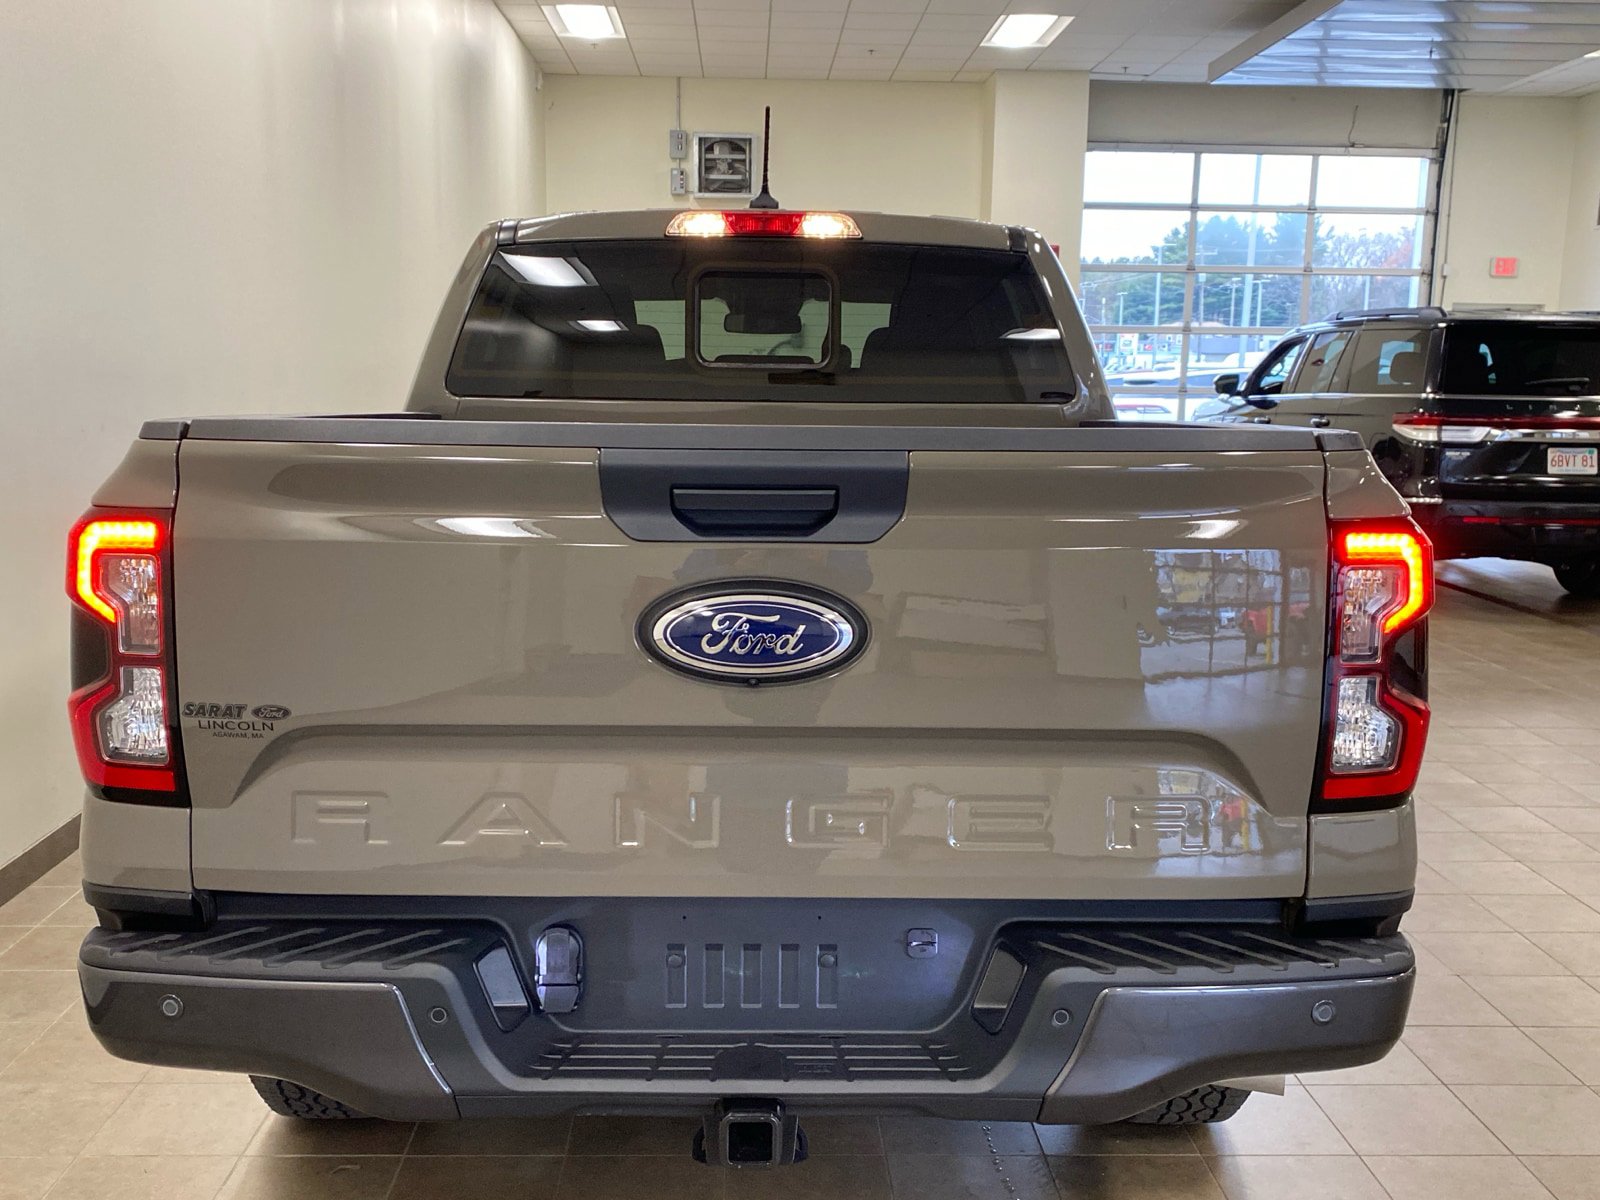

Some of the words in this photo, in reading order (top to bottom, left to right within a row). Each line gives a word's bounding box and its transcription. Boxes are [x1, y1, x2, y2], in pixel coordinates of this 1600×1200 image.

[1550, 454, 1577, 468] 6BVT
[1581, 454, 1596, 468] 81
[701, 612, 807, 655] Ford
[182, 702, 247, 719] SARAT
[258, 706, 284, 719] Ford
[197, 720, 274, 732] LINCOLN
[212, 731, 250, 740] AGAWAM,
[290, 790, 1209, 852] RANGER
